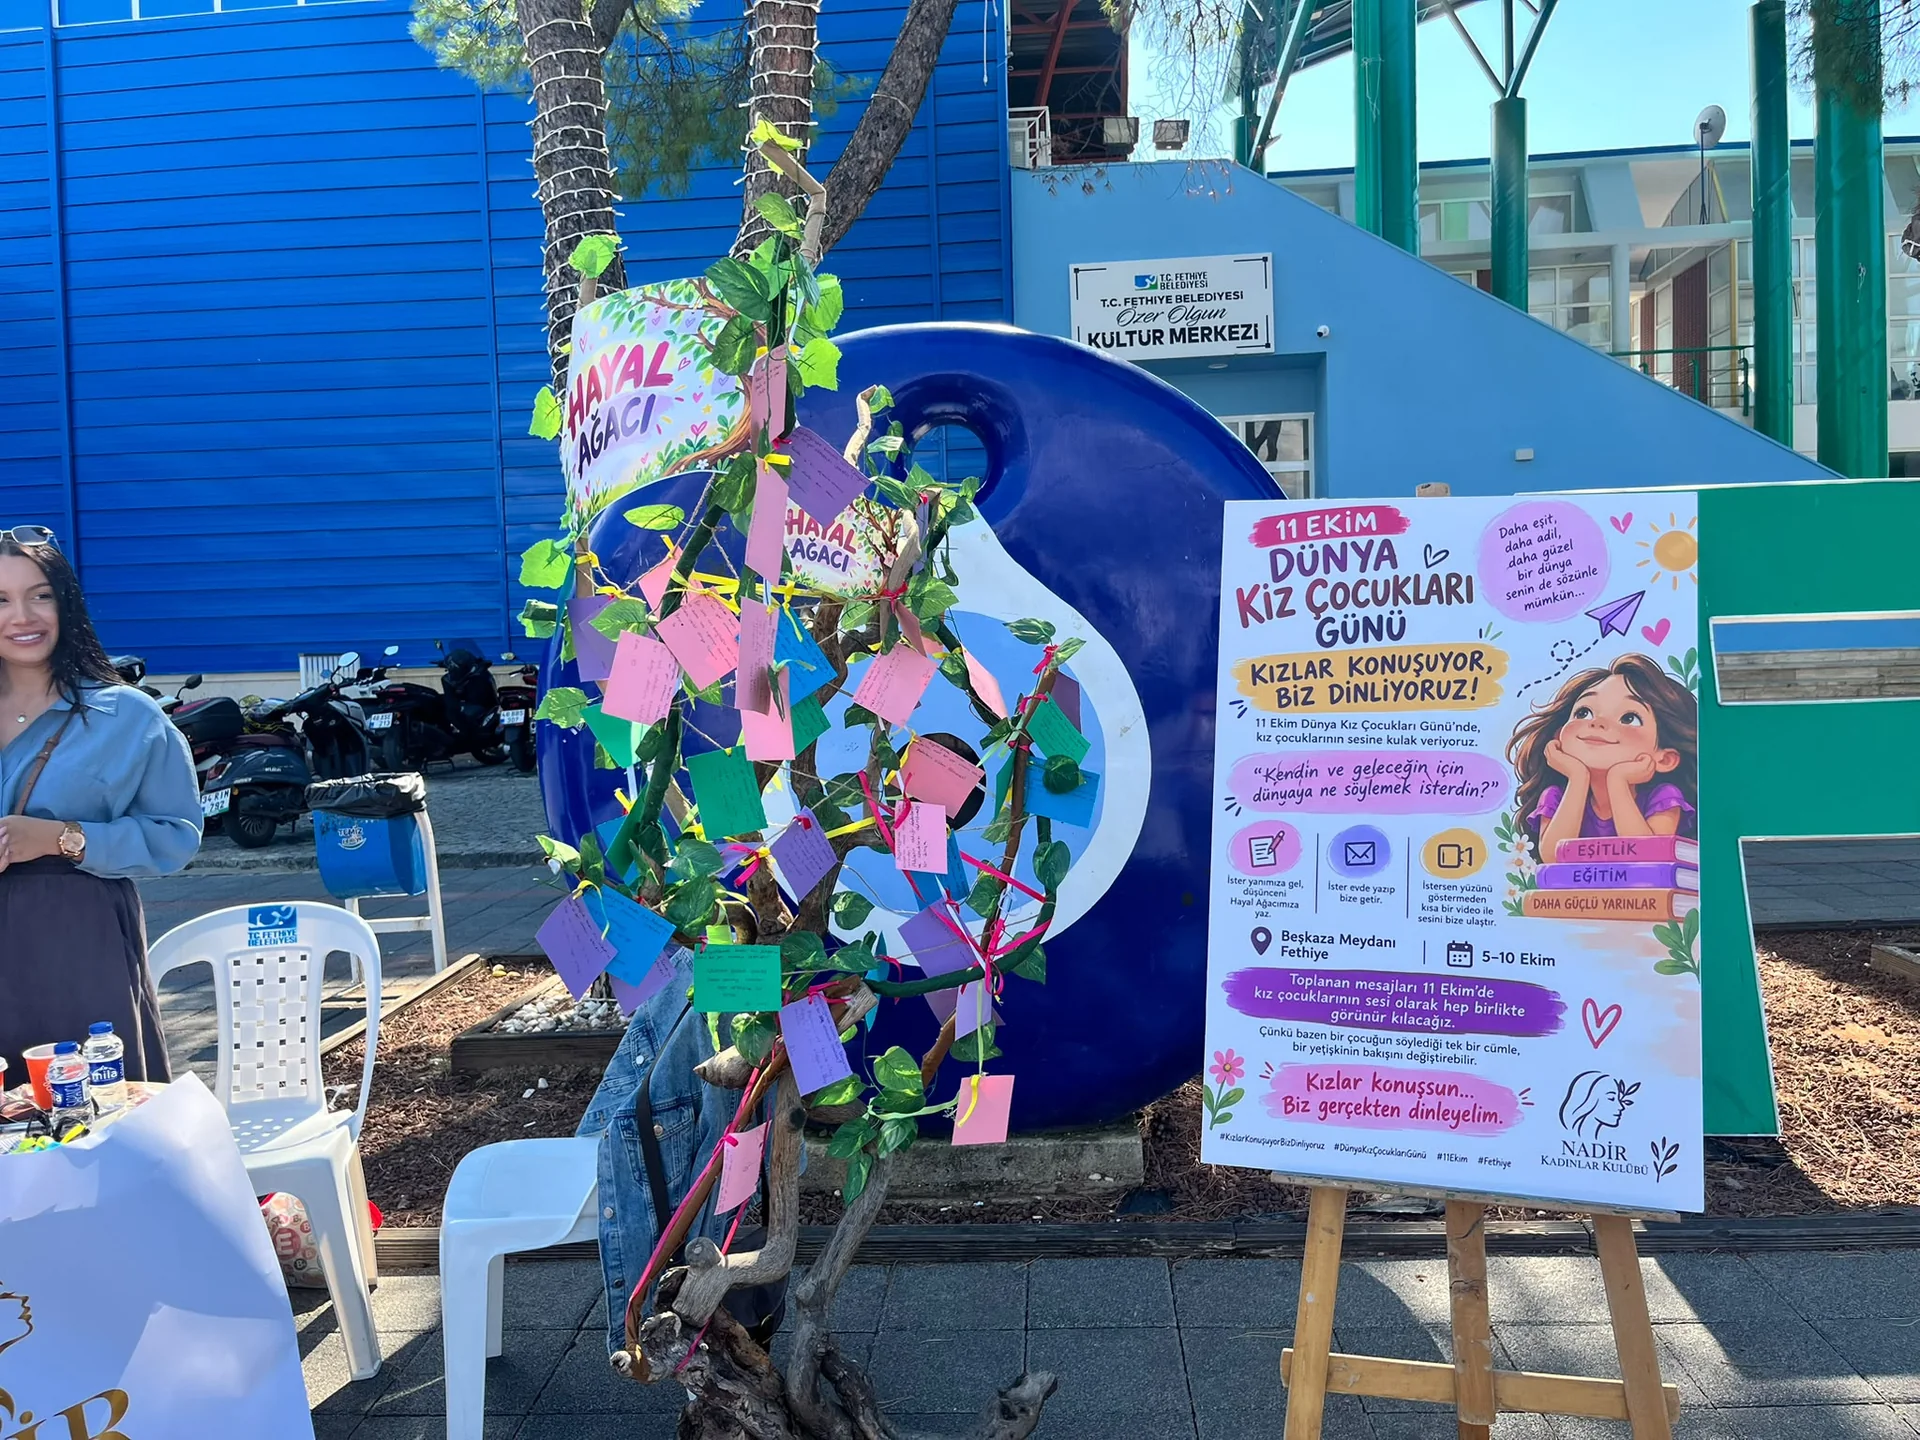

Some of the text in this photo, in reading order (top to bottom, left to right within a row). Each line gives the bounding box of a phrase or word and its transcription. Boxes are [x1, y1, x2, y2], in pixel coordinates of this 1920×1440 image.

[1160, 280, 1208, 290] BELEDİYESİ
[1175, 272, 1207, 281] FETHİYE
[1101, 299, 1121, 308] T.C.
[1116, 305, 1228, 327] Özer Olgun
[1088, 323, 1258, 348] KÜLTÜR MERKEZİ
[568, 341, 673, 441] HAYAL
[578, 393, 656, 479] AĞACI
[785, 509, 856, 554] HAYAL
[1275, 510, 1378, 541] 11 EKİM
[1499, 512, 1558, 539] Daha eşit,
[1505, 527, 1562, 553] daha adil,
[790, 537, 849, 572] AĞACI
[1269, 538, 1398, 583] DÜNYA
[1507, 539, 1574, 569] daha güzel
[1517, 558, 1573, 581] bir dünya
[1506, 565, 1598, 601] senin de sözünle
[1305, 573, 1474, 620] ÇOCUKLARI
[1524, 591, 1585, 612] mümkün...
[1315, 610, 1406, 648] GÜNÜ
[1251, 650, 1493, 686] KIZLAR KONUŞUYOR,
[1276, 677, 1479, 708] BİZ DİNLİYORUZ!
[1255, 718, 1267, 728] 11
[1270, 718, 1297, 728] Ekim
[1301, 718, 1338, 733] Dünya
[1340, 719, 1358, 730] Kız
[1361, 719, 1416, 733] Çocukları
[1256, 733, 1478, 748] kız çocuklarının sesine kulak veriyoruz.
[1328, 765, 1344, 777] ve
[1353, 759, 1428, 780] geleceğin
[1436, 761, 1464, 777] için
[1253, 783, 1314, 805] dünyaya
[1320, 786, 1338, 797] ne
[1344, 778, 1412, 801] söylemek
[1578, 843, 1637, 857] EŞİTLİK
[1227, 875, 1304, 890] İster yanımıza gel,
[1573, 868, 1627, 883] EĞİTİM
[1243, 886, 1287, 898] düşünceni
[1328, 881, 1395, 896] İster evde yazıp
[1340, 894, 1383, 905] bize getir.
[1422, 881, 1493, 896] İstersen yüzünü
[1428, 893, 1487, 906] göstermeden
[1230, 896, 1299, 910] Hayal Ağacımıza
[1254, 909, 1272, 919] yaz.
[1421, 902, 1494, 915] kısa bir video ile
[1533, 898, 1657, 912] DAHA GÜÇLÜ YARINLAR
[1418, 914, 1497, 927] sesini bize ulaştır.
[1281, 930, 1396, 949] Beşkaza Meydanı
[1281, 946, 1329, 961] Fethiye
[1520, 952, 1556, 967] Ekim
[1289, 972, 1495, 999] Toplanan mesajları 11 Ekim'de
[1254, 987, 1526, 1017] kız çocuklarının sesi olarak hep birlikte
[1330, 1007, 1456, 1031] görünür kılacağız.
[1259, 1025, 1521, 1057] Çünkü bazen bir çocuğun söylediği tek bir cümle,
[1292, 1042, 1478, 1066] bir yetişkinin bakışını değiştirebilir.
[1306, 1072, 1474, 1099] Kızlar konuşsun...
[1283, 1095, 1503, 1129] Biz gerçekten dinleyelim.
[1334, 1141, 1427, 1160] #DünyaKızÇocuklarıGünü
[1436, 1151, 1468, 1164] #11Ekim
[1478, 1155, 1512, 1169] #Fethiye
[1562, 1139, 1628, 1161] NADİR
[1541, 1155, 1600, 1170] KADINLAR
